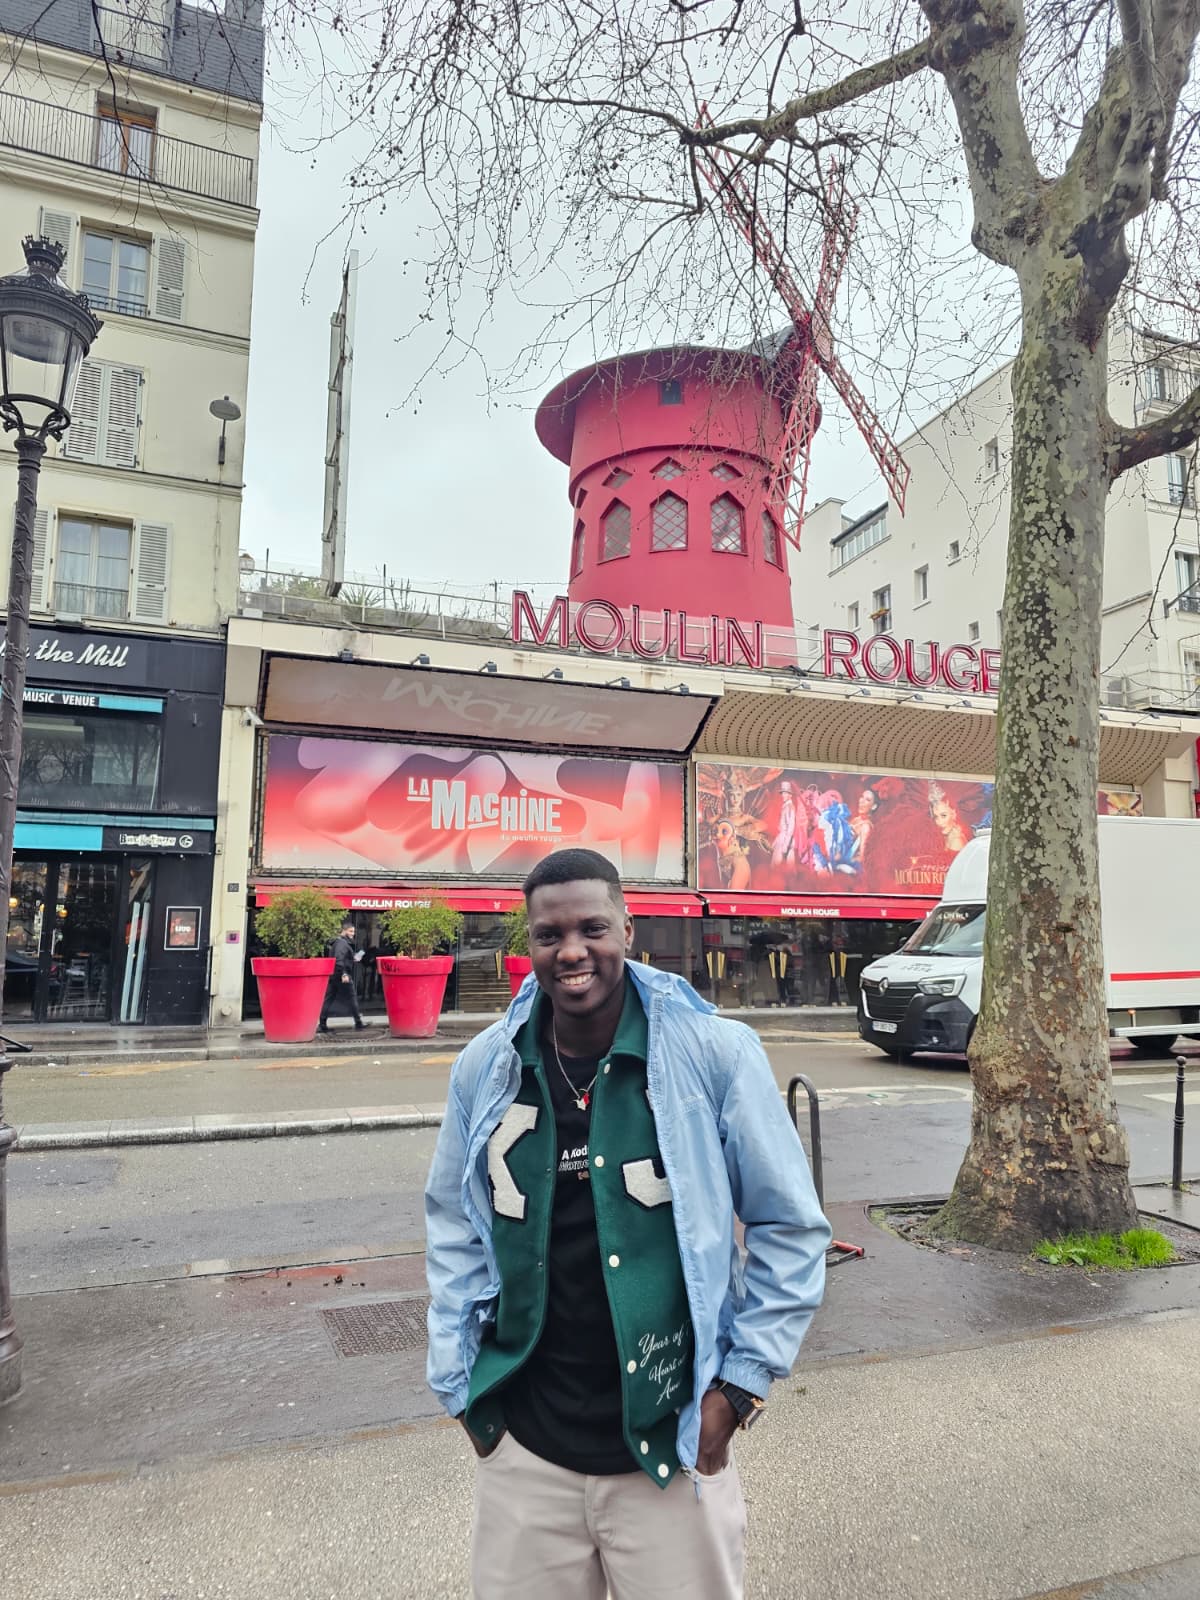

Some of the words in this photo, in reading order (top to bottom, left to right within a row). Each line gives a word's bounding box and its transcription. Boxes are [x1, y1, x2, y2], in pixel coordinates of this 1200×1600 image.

[512, 589, 763, 669] MOULIN
[823, 628, 1000, 693] ROUGE
[34, 639, 74, 662] the
[76, 643, 129, 667] Mill
[22, 691, 55, 703] MUSIC
[62, 694, 96, 706] VENUE
[408, 777, 430, 800] LA
[895, 869, 929, 884] MOULIN
[351, 898, 392, 908] MOULIN
[781, 907, 811, 915] MOULIN
[813, 908, 840, 916] ROUGE
[562, 1149, 569, 1161] A
[638, 1333, 669, 1368] Year
[648, 1358, 677, 1384] Heart
